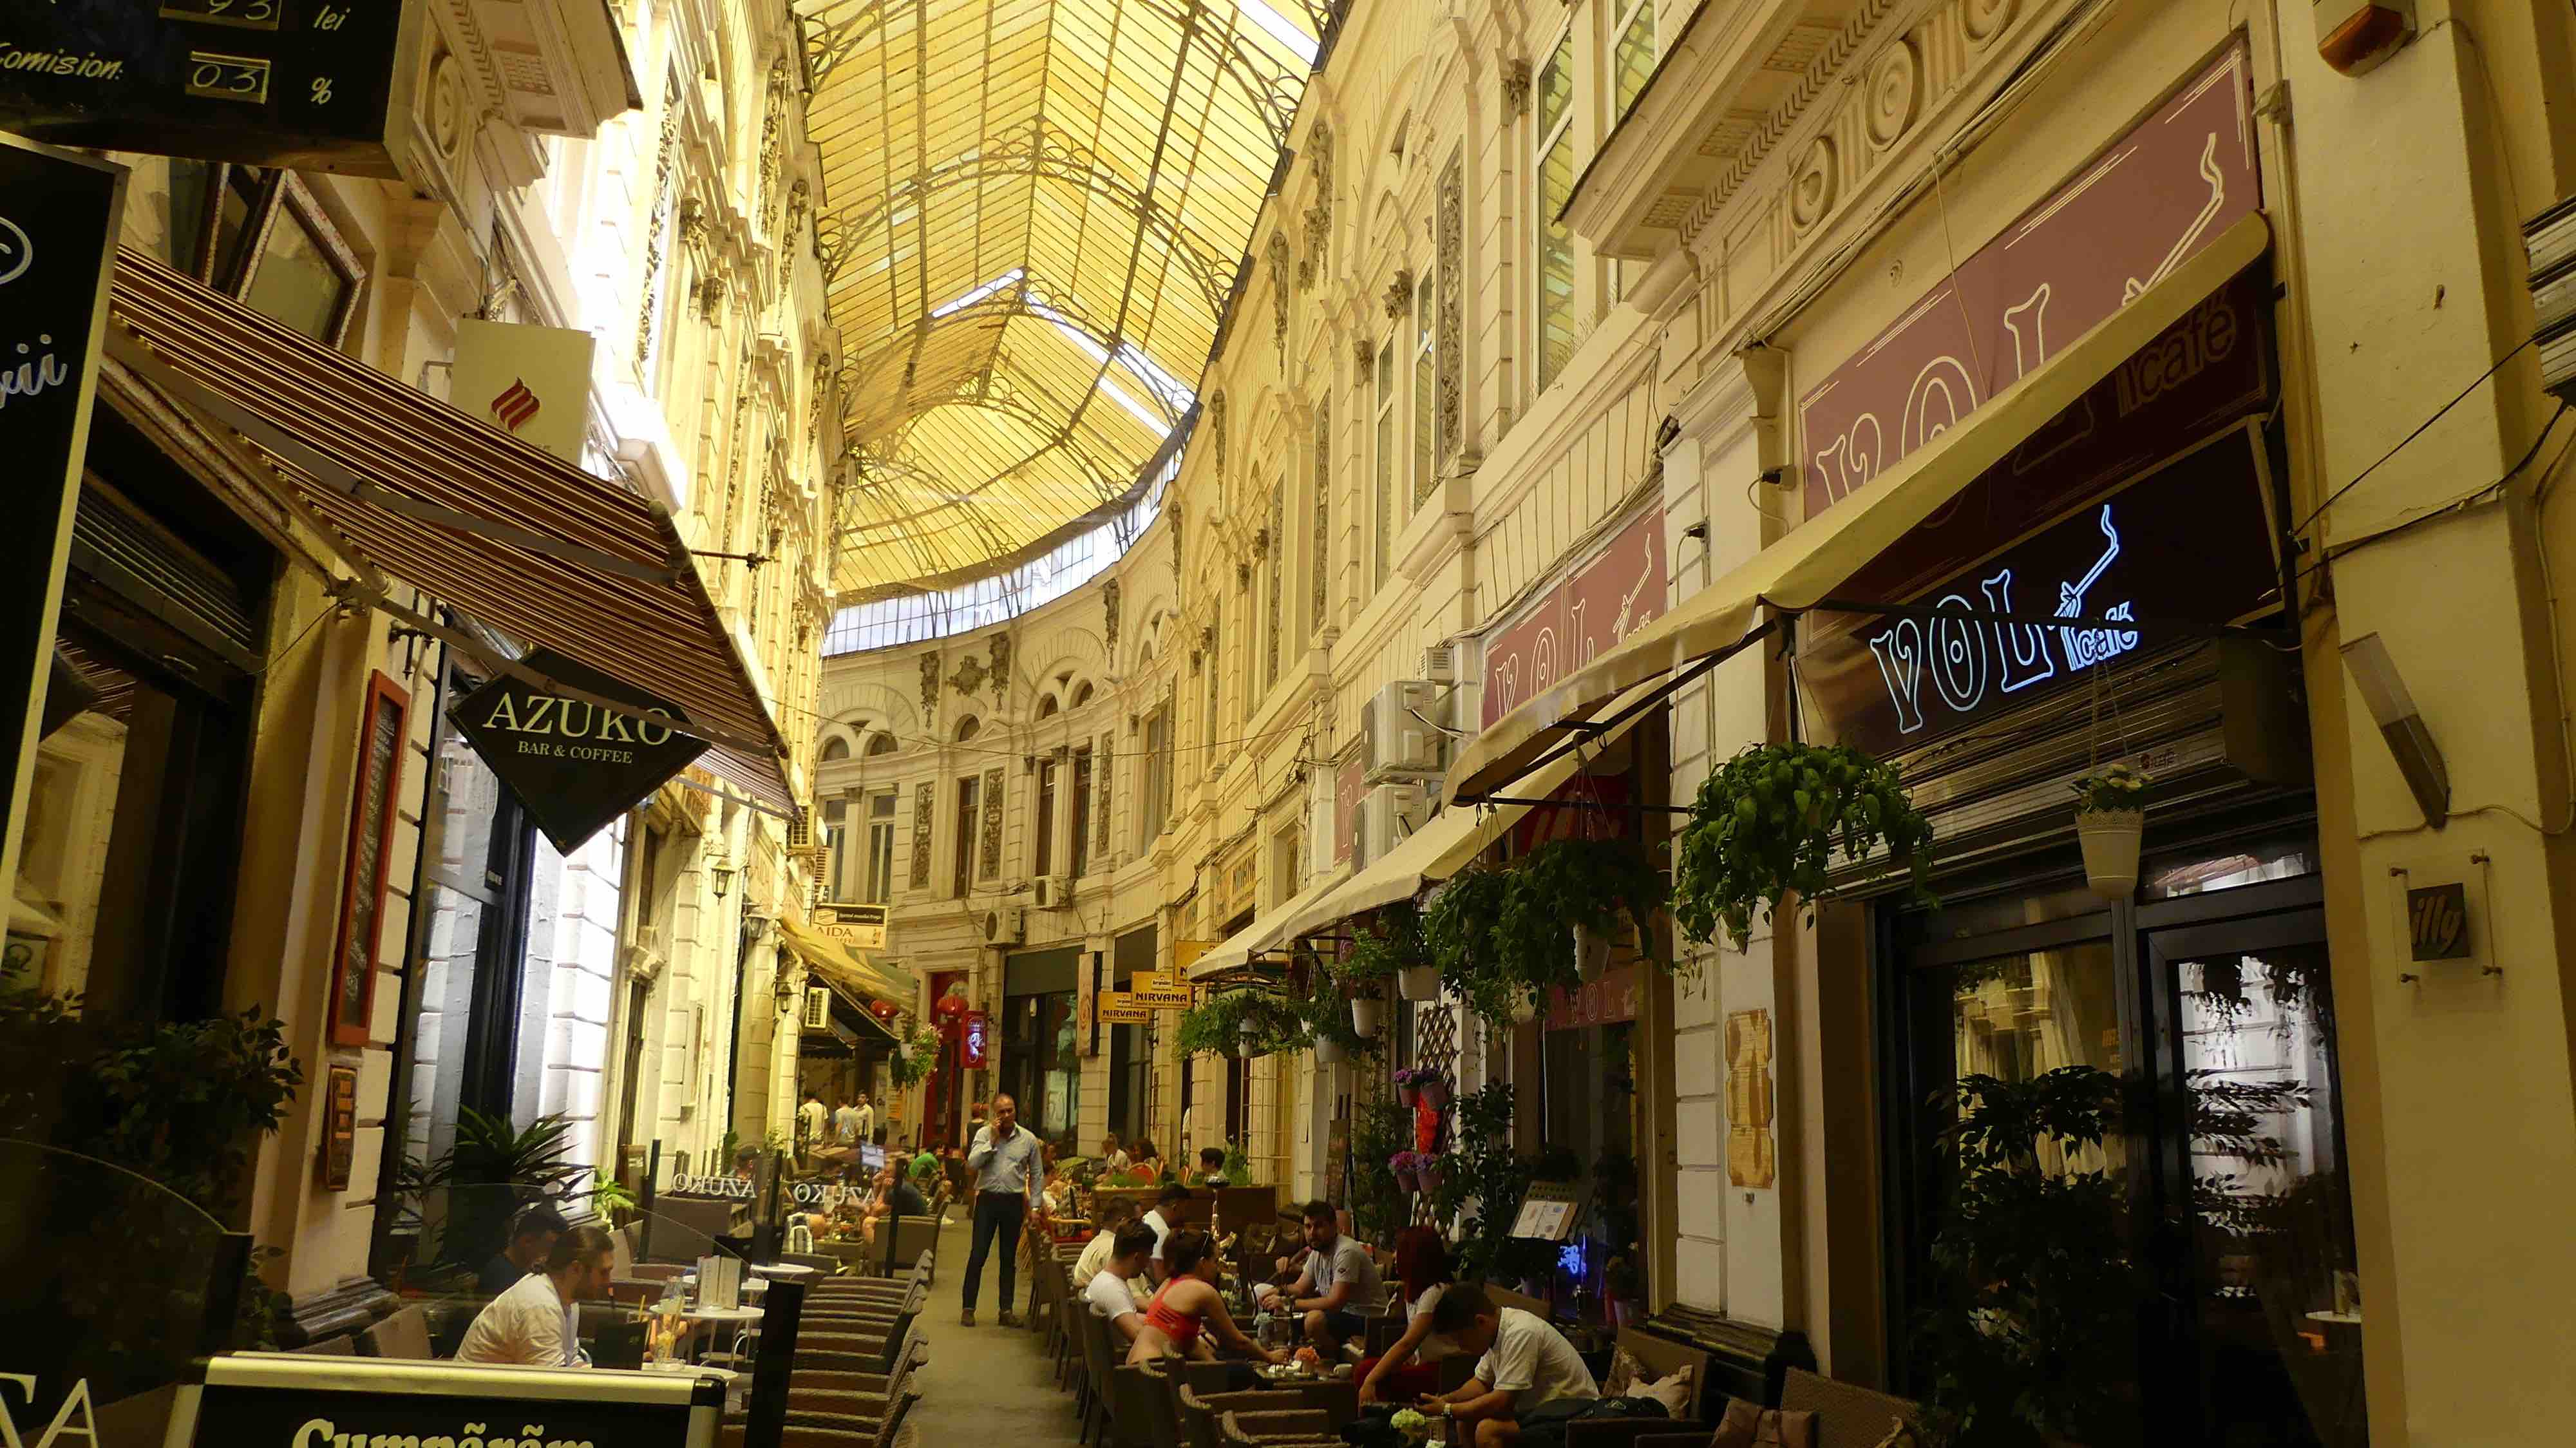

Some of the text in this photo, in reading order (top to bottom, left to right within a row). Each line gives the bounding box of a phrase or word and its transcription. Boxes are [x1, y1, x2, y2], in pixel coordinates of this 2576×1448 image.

[314, 5, 350, 31] lei
[193, 64, 257, 92] 03
[310, 77, 333, 104] %
[482, 692, 672, 745] AZUKO
[516, 740, 633, 763] BAR & COFFEE
[2414, 895, 2464, 956] illy
[1136, 993, 1188, 1002] NIRVANA
[1103, 1009, 1146, 1018] NIRVANA
